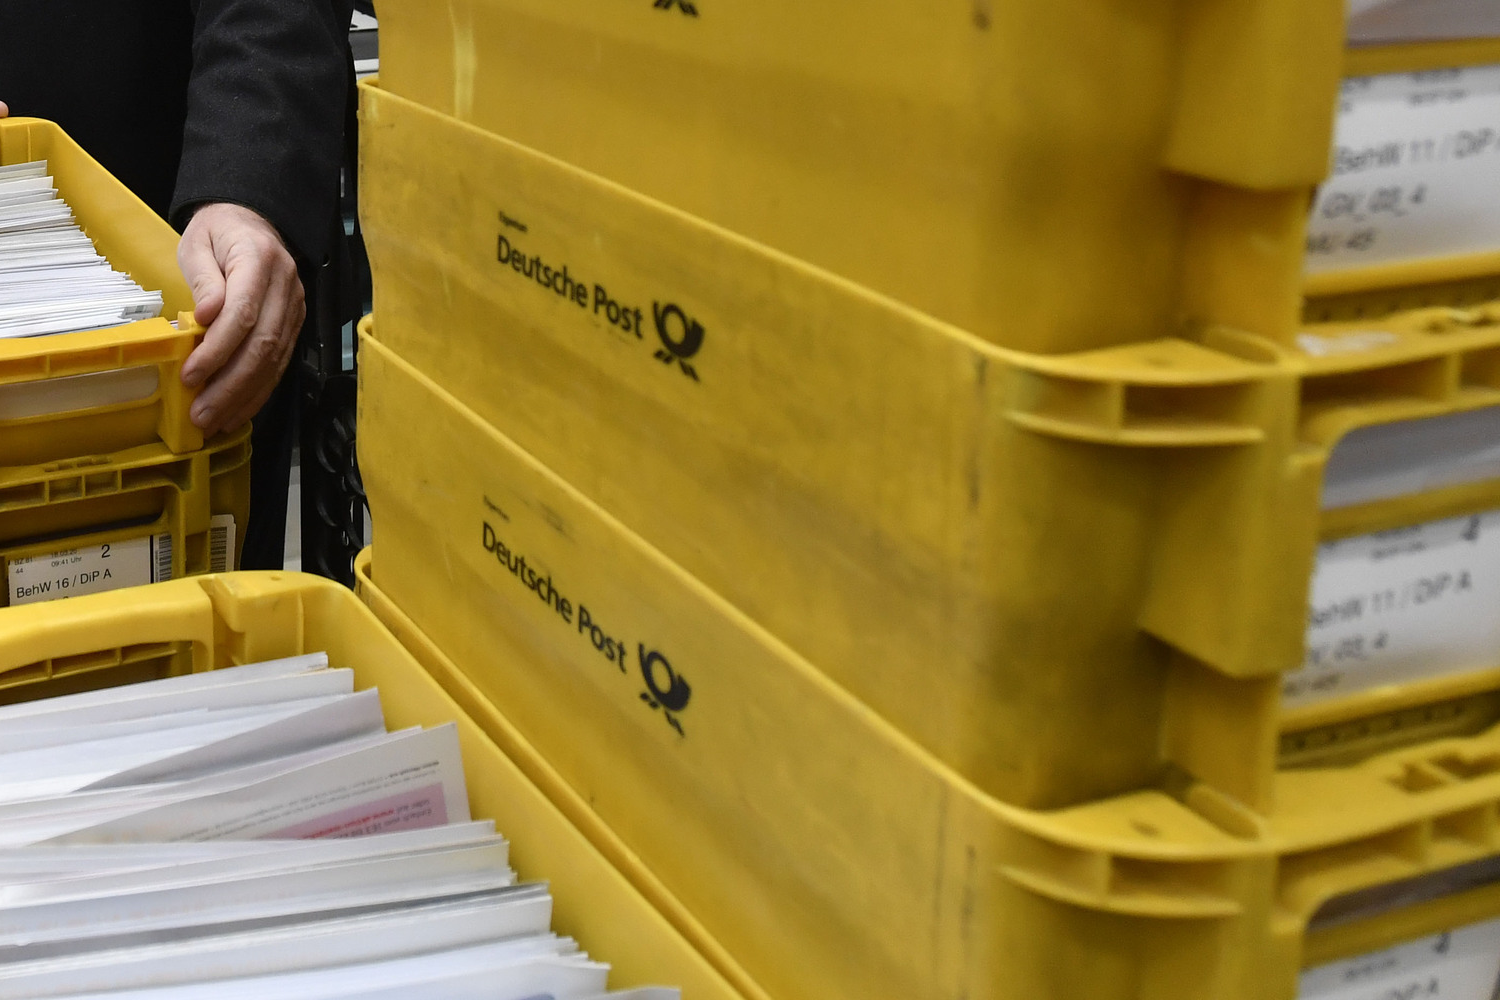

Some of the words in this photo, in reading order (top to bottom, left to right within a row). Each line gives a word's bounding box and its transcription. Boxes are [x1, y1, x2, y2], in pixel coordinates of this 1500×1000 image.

[496, 234, 588, 309] Deutsche
[593, 283, 643, 340] Post
[70, 555, 83, 565] Uhr
[100, 543, 112, 559] 2
[16, 581, 52, 599] BehW
[55, 577, 70, 590] 16
[80, 569, 100, 585] DiP
[103, 568, 113, 580] A
[481, 519, 574, 625] Deutsche
[577, 603, 627, 675] Post
